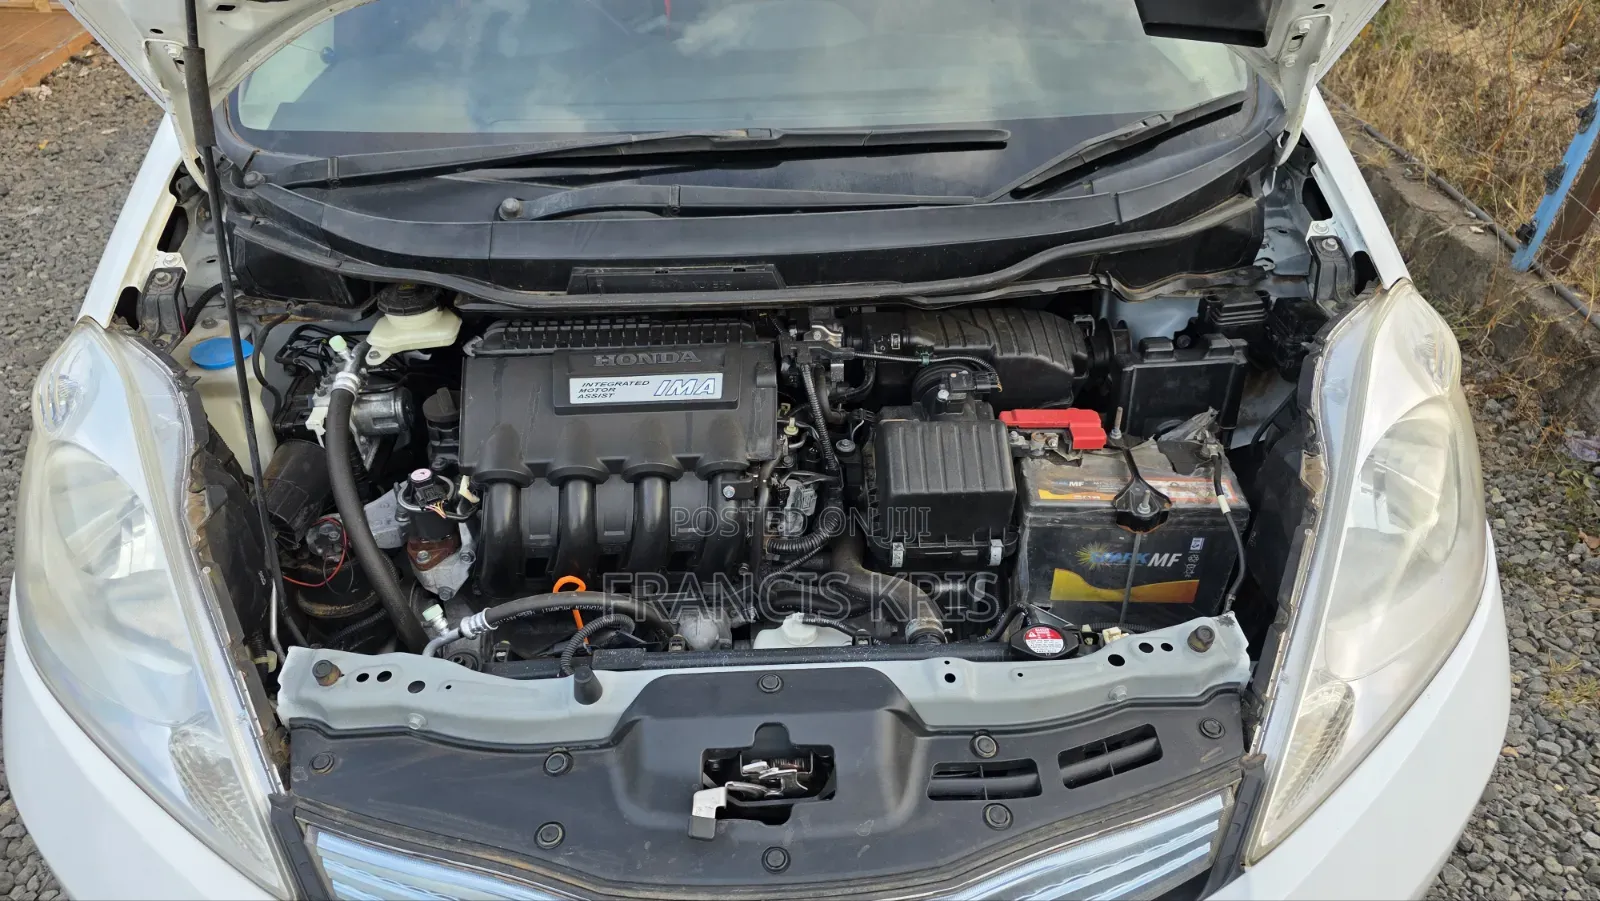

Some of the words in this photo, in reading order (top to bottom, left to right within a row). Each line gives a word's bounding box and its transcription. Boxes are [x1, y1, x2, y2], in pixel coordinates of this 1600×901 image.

[594, 350, 701, 366] HONDA
[581, 380, 650, 388] INTEGRATED
[653, 378, 715, 396] IMA
[1147, 553, 1182, 567] MF
